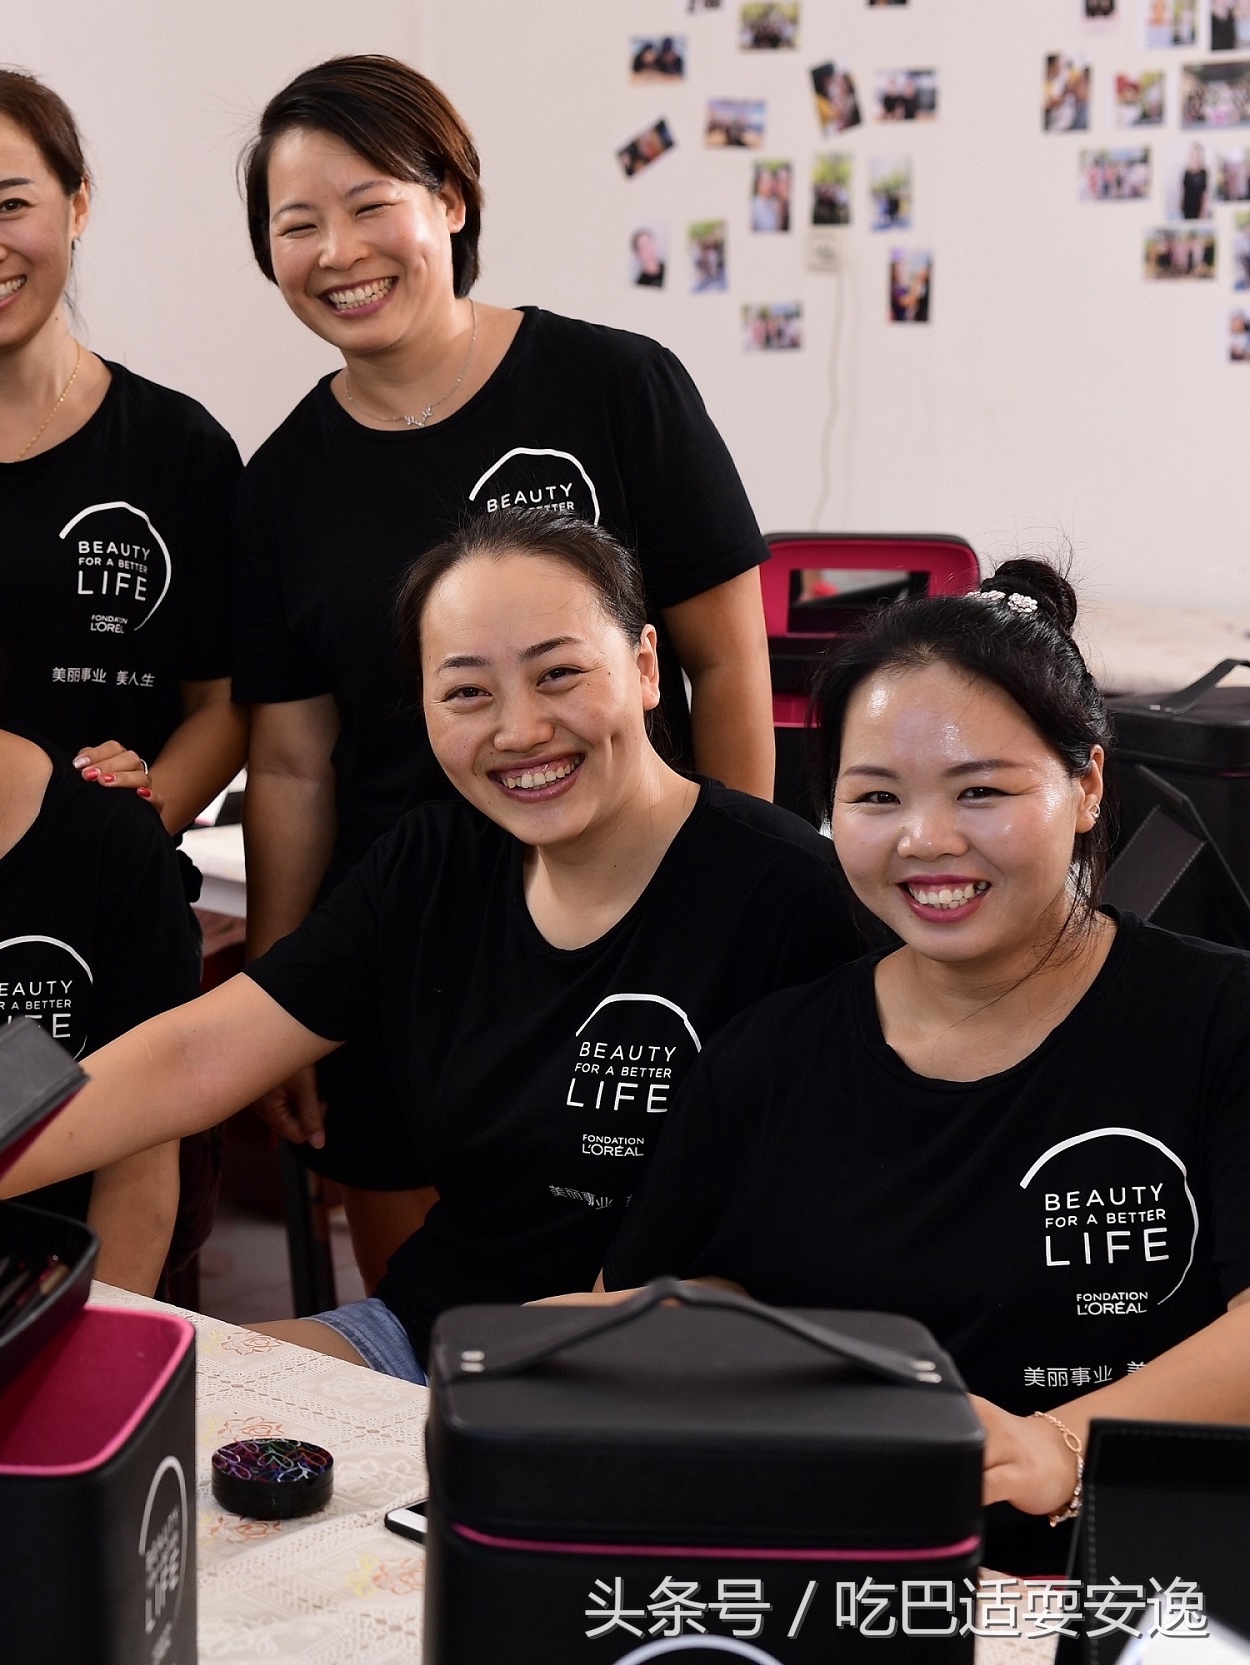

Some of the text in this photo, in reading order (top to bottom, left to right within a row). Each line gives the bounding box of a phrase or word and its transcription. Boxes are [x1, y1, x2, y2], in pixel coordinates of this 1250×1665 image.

[486, 482, 573, 513] BEAUTY
[528, 501, 574, 512] TER
[78, 541, 150, 561] BEAUTY
[78, 557, 148, 574] FOR A BETTER
[77, 570, 147, 601] LIFE
[52, 667, 107, 683] 美丽事业
[11, 1001, 19, 1010] A
[25, 999, 72, 1010] BETTER
[579, 1041, 676, 1062] BEAUTY
[574, 1063, 672, 1078] FOR A BETTER
[566, 1077, 670, 1113] LIFE
[582, 1133, 645, 1145] FONDATION
[1045, 1183, 1163, 1211] BEAUTY
[1045, 1208, 1166, 1229] FOR A BETTER
[1045, 1227, 1169, 1267] LIFE
[1076, 1291, 1148, 1302] FONDATION
[1023, 1365, 1113, 1387] 美丽事业
